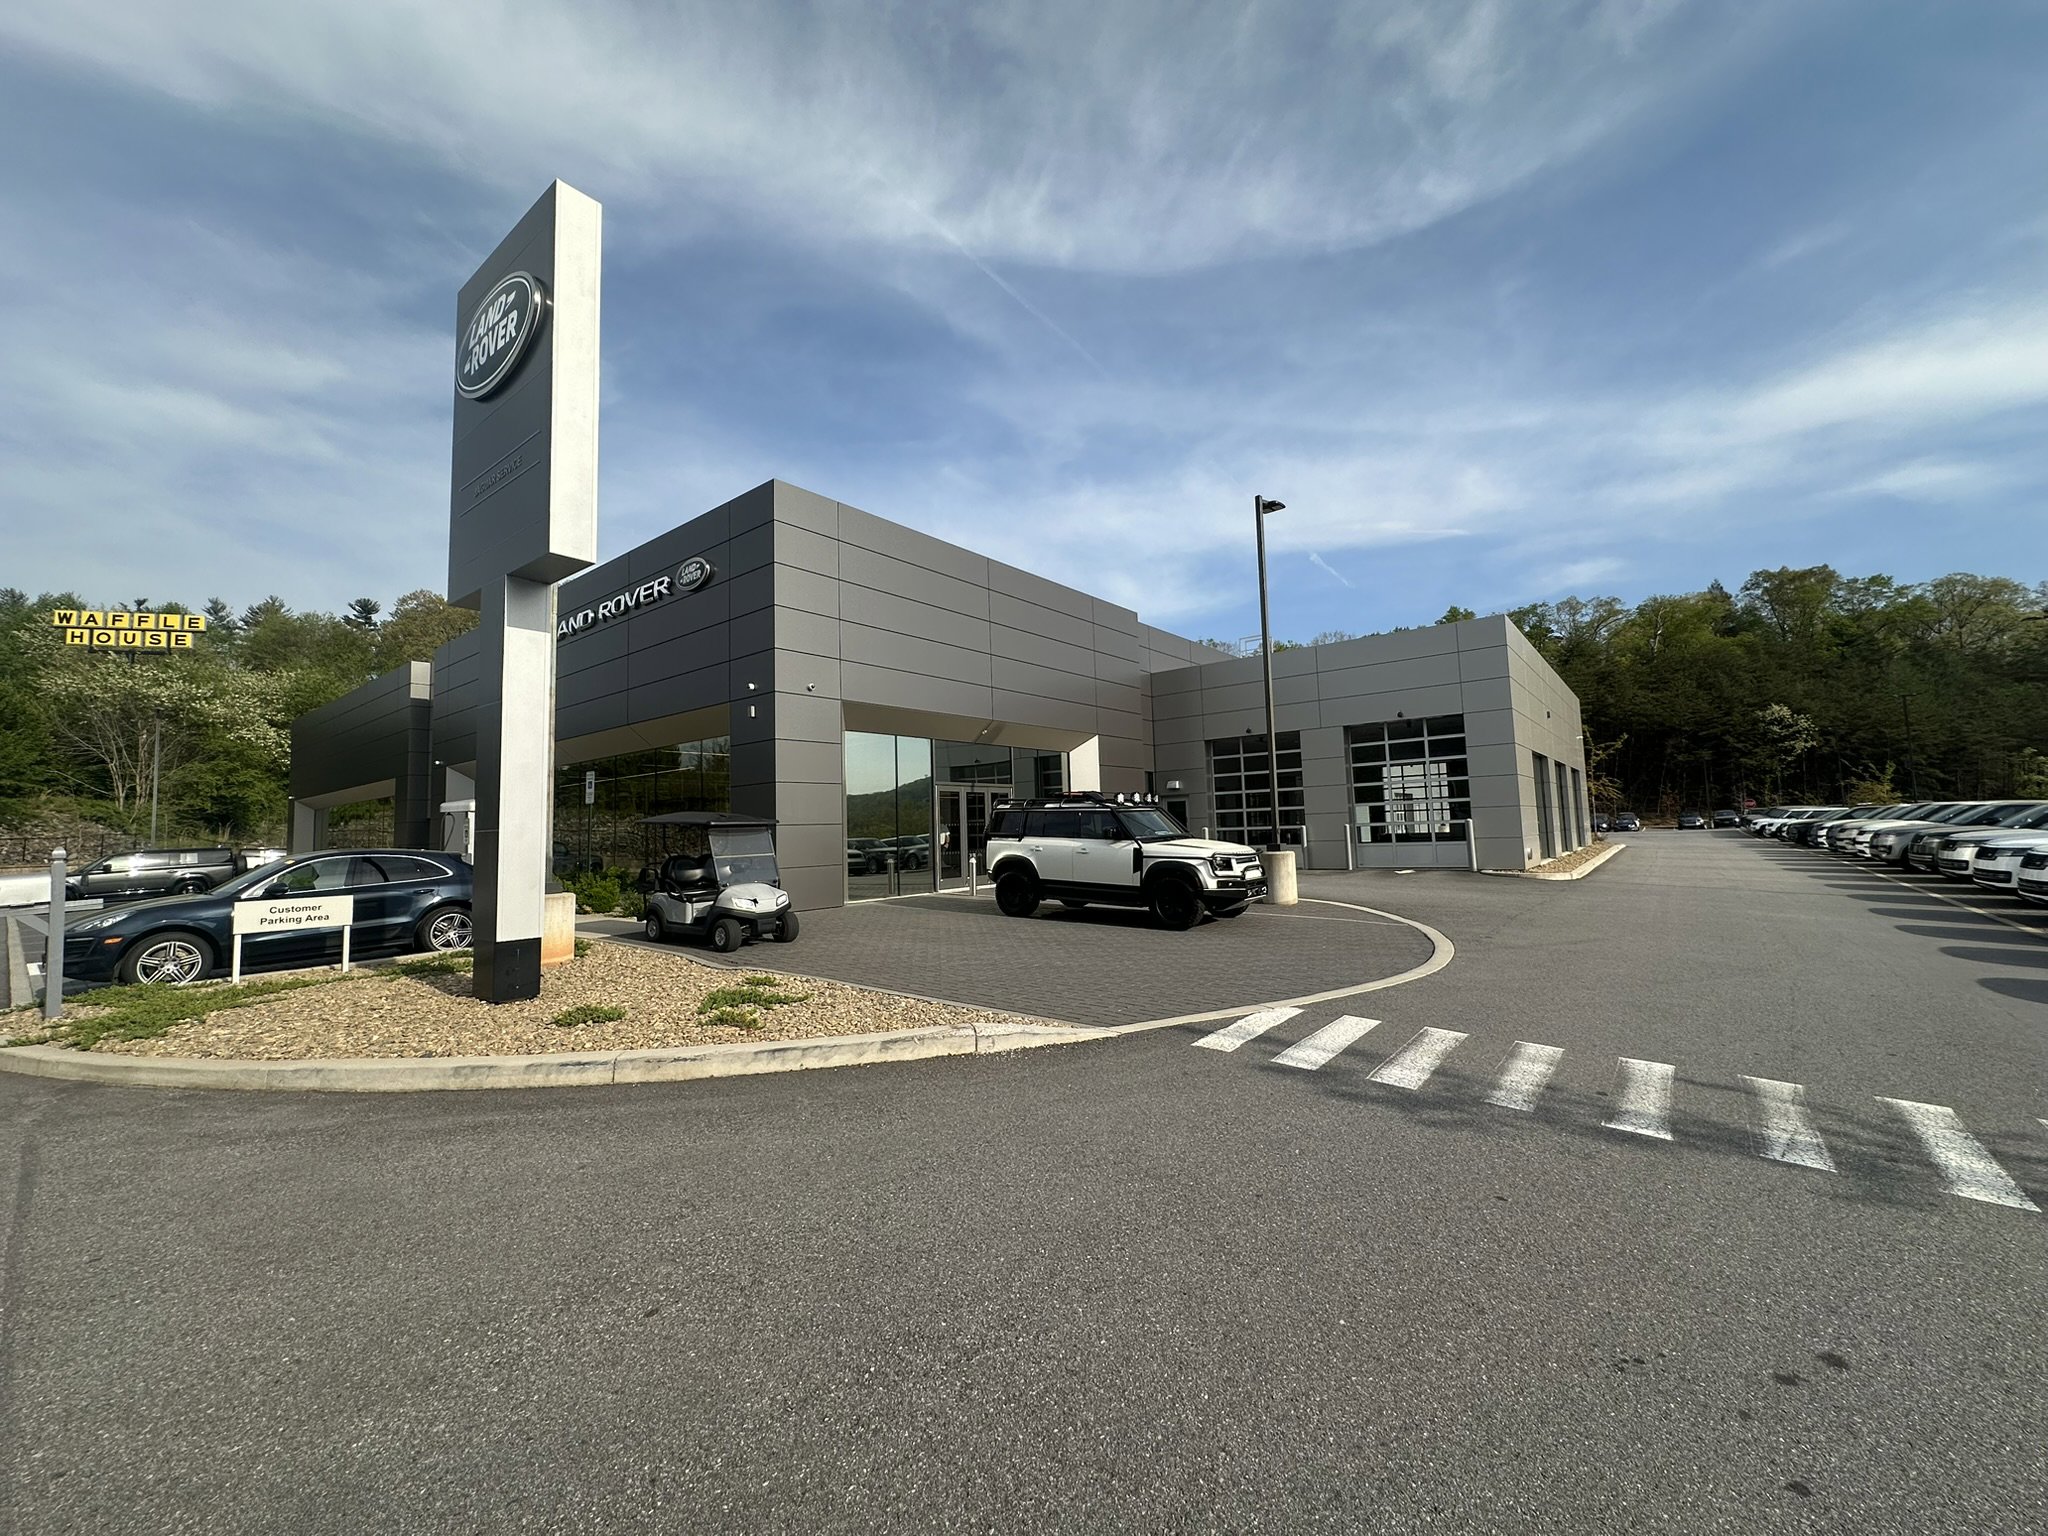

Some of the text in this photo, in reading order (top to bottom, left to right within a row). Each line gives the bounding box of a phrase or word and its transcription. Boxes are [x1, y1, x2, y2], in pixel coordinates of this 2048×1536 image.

[469, 293, 507, 351] LAND
[470, 309, 518, 376] ROVER
[682, 569, 702, 584] ROVER
[557, 576, 671, 637] AND ROVER
[57, 612, 201, 629] WAFFLE
[70, 631, 187, 646] HOUSE
[269, 905, 323, 914] Customer
[260, 914, 330, 925] Parking Area
